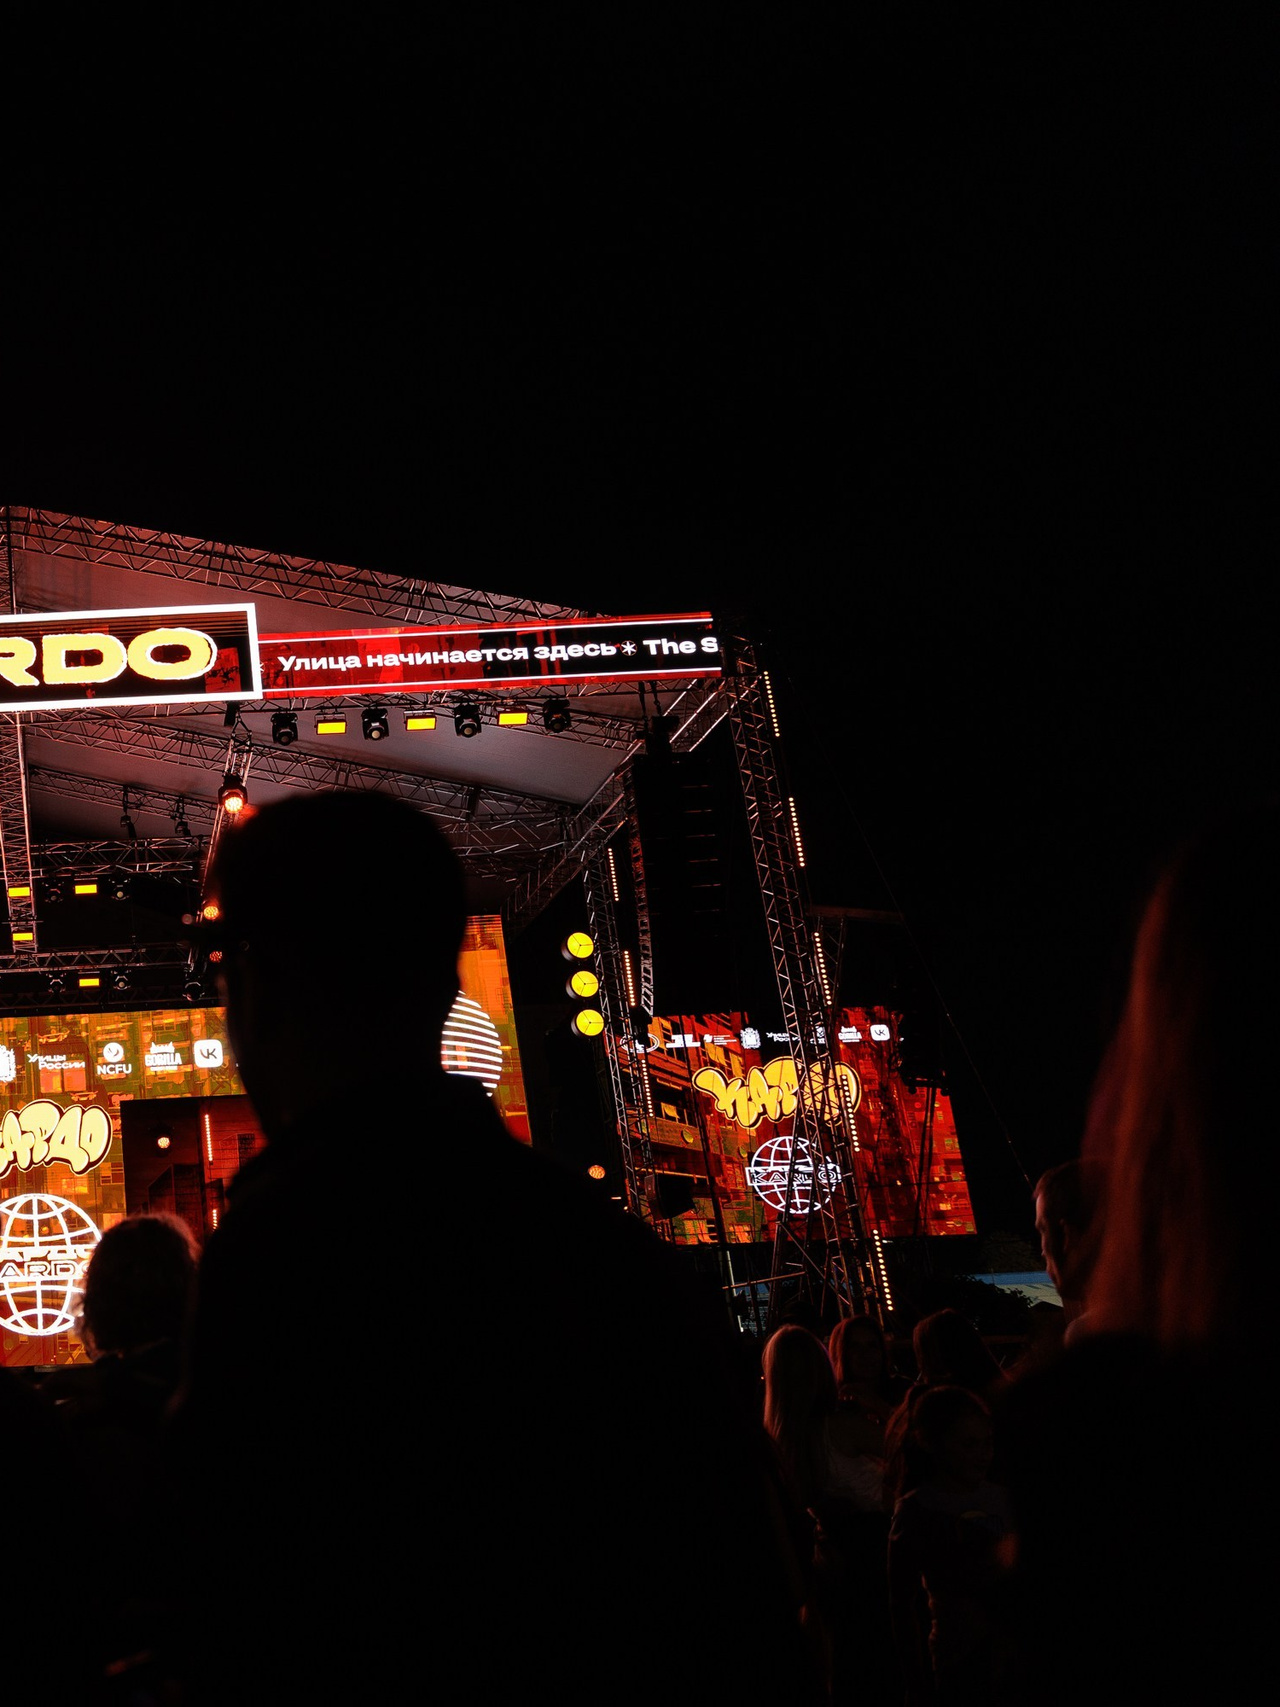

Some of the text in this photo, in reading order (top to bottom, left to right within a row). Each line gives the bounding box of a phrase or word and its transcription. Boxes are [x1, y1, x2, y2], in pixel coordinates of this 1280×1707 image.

[642, 638, 697, 655] The
[277, 644, 617, 672] Улица начинается здесь
[97, 1064, 132, 1075] NCFU
